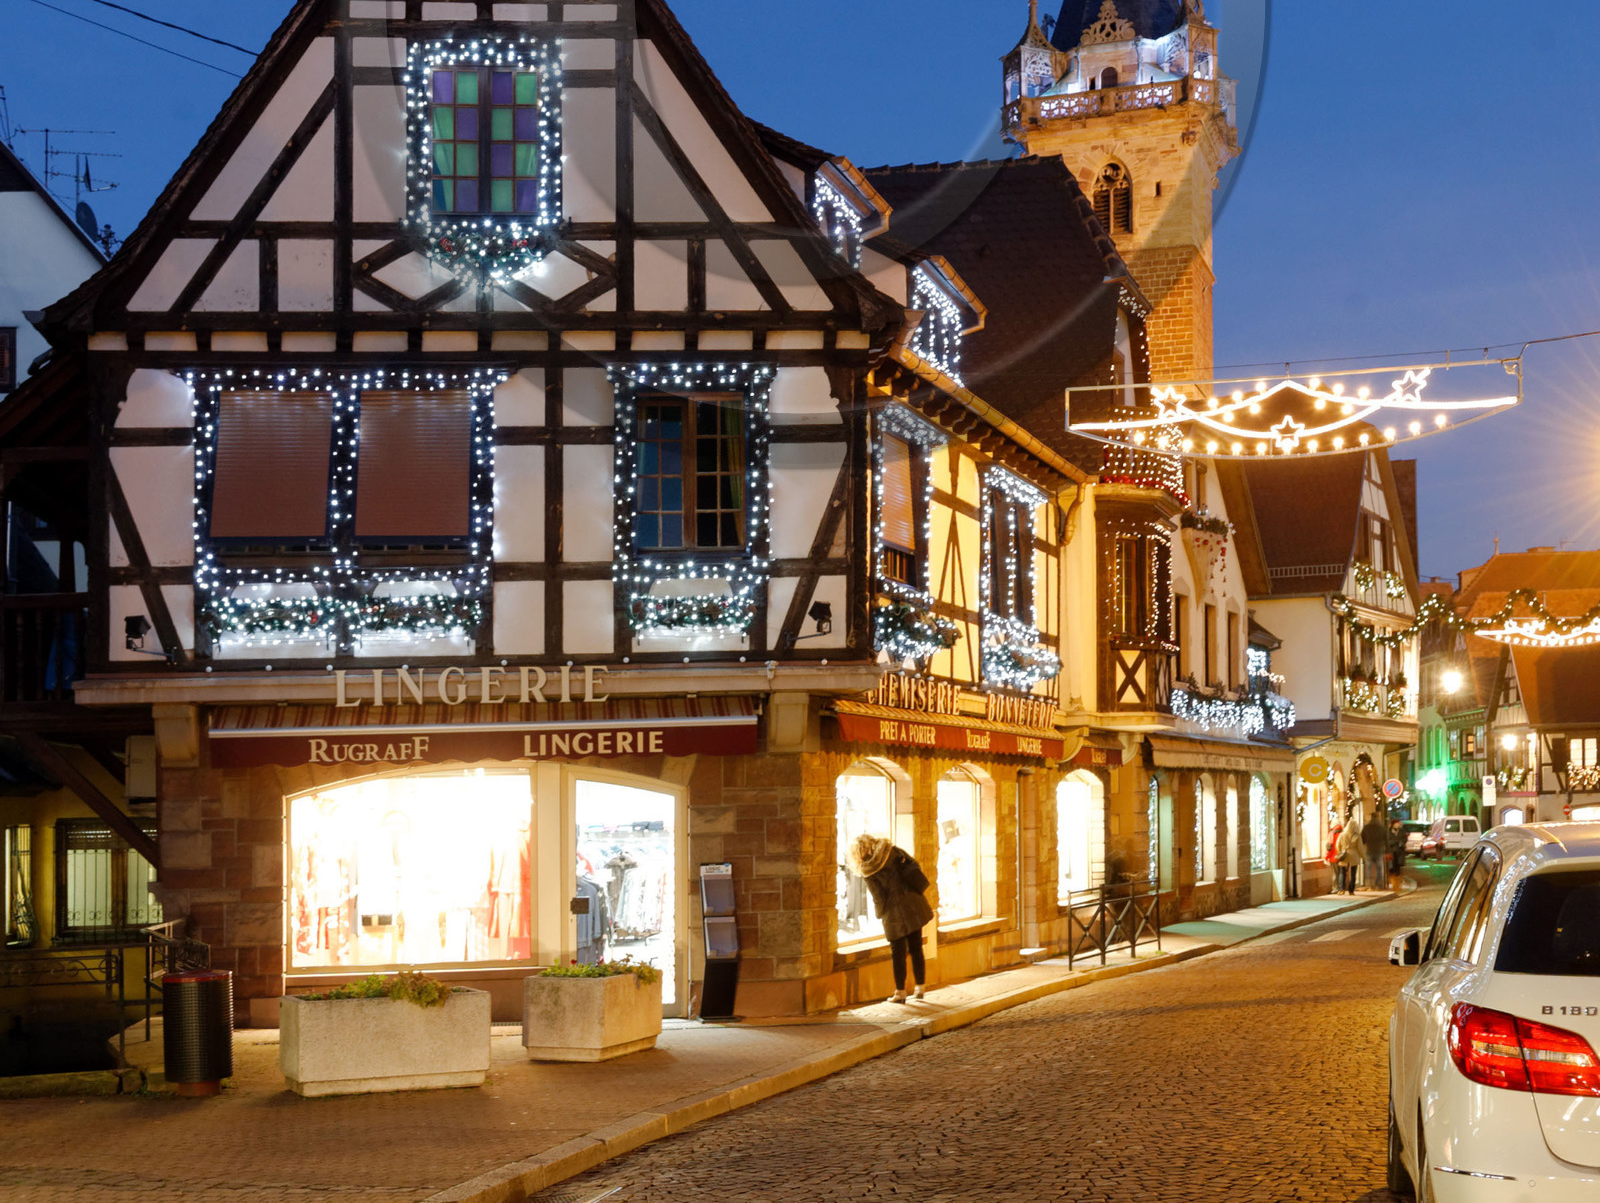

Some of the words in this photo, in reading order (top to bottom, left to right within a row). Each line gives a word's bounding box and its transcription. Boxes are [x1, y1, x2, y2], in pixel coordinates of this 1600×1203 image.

[335, 665, 609, 708] LINGERIE
[987, 694, 1057, 729] BONNETERIE
[524, 730, 664, 757] LINGERIE
[880, 720, 898, 741] PRET
[900, 723, 907, 742] A
[909, 724, 936, 745] PORTER
[1016, 736, 1042, 755] LINGERIE
[1542, 1005, 1553, 1015] B
[1560, 1006, 1598, 1016] 180
